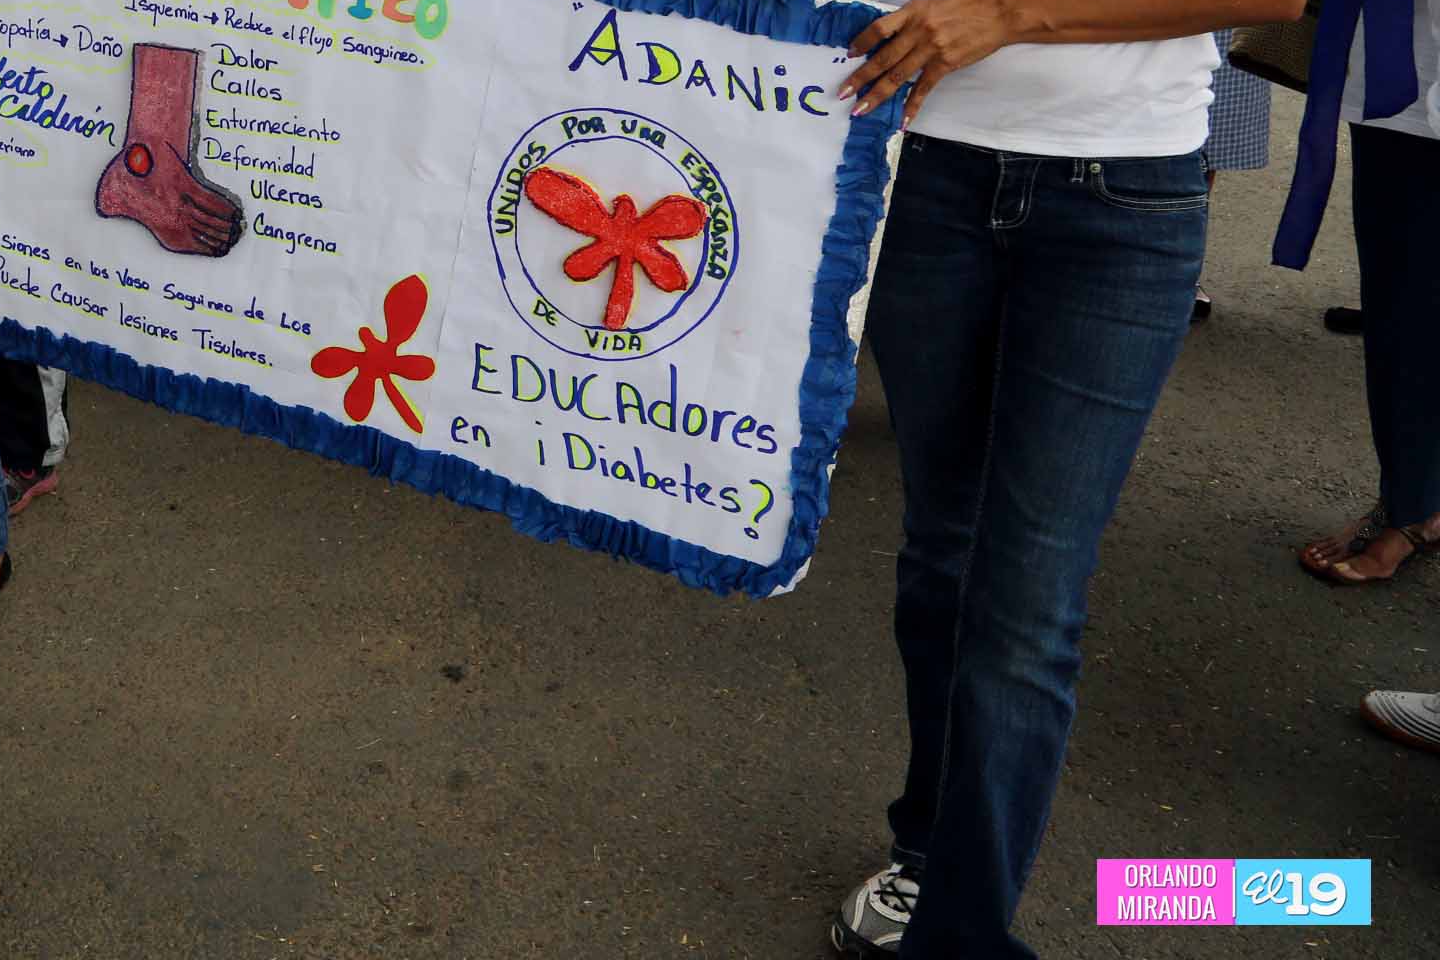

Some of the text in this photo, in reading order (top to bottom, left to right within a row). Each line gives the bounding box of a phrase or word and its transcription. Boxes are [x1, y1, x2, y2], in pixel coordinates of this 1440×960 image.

[72, 24, 124, 58] Daño
[224, 7, 273, 36] Reduce
[282, 26, 294, 41] el
[299, 27, 333, 54] flujo
[210, 42, 278, 71] Dolor
[210, 69, 283, 102] Callos
[206, 108, 341, 142] Enturmeciento
[203, 136, 315, 178] Deformidad
[250, 179, 323, 209] Ulceras
[253, 212, 337, 254] Cangrena
[64, 257, 82, 271] en
[90, 261, 109, 279] los
[116, 269, 150, 291] Vaso
[244, 296, 265, 321] de
[280, 312, 312, 336] Los
[50, 283, 109, 317] Causar
[119, 303, 178, 341] lesiones
[191, 328, 273, 367] Tisulares.
[450, 416, 491, 448] en
